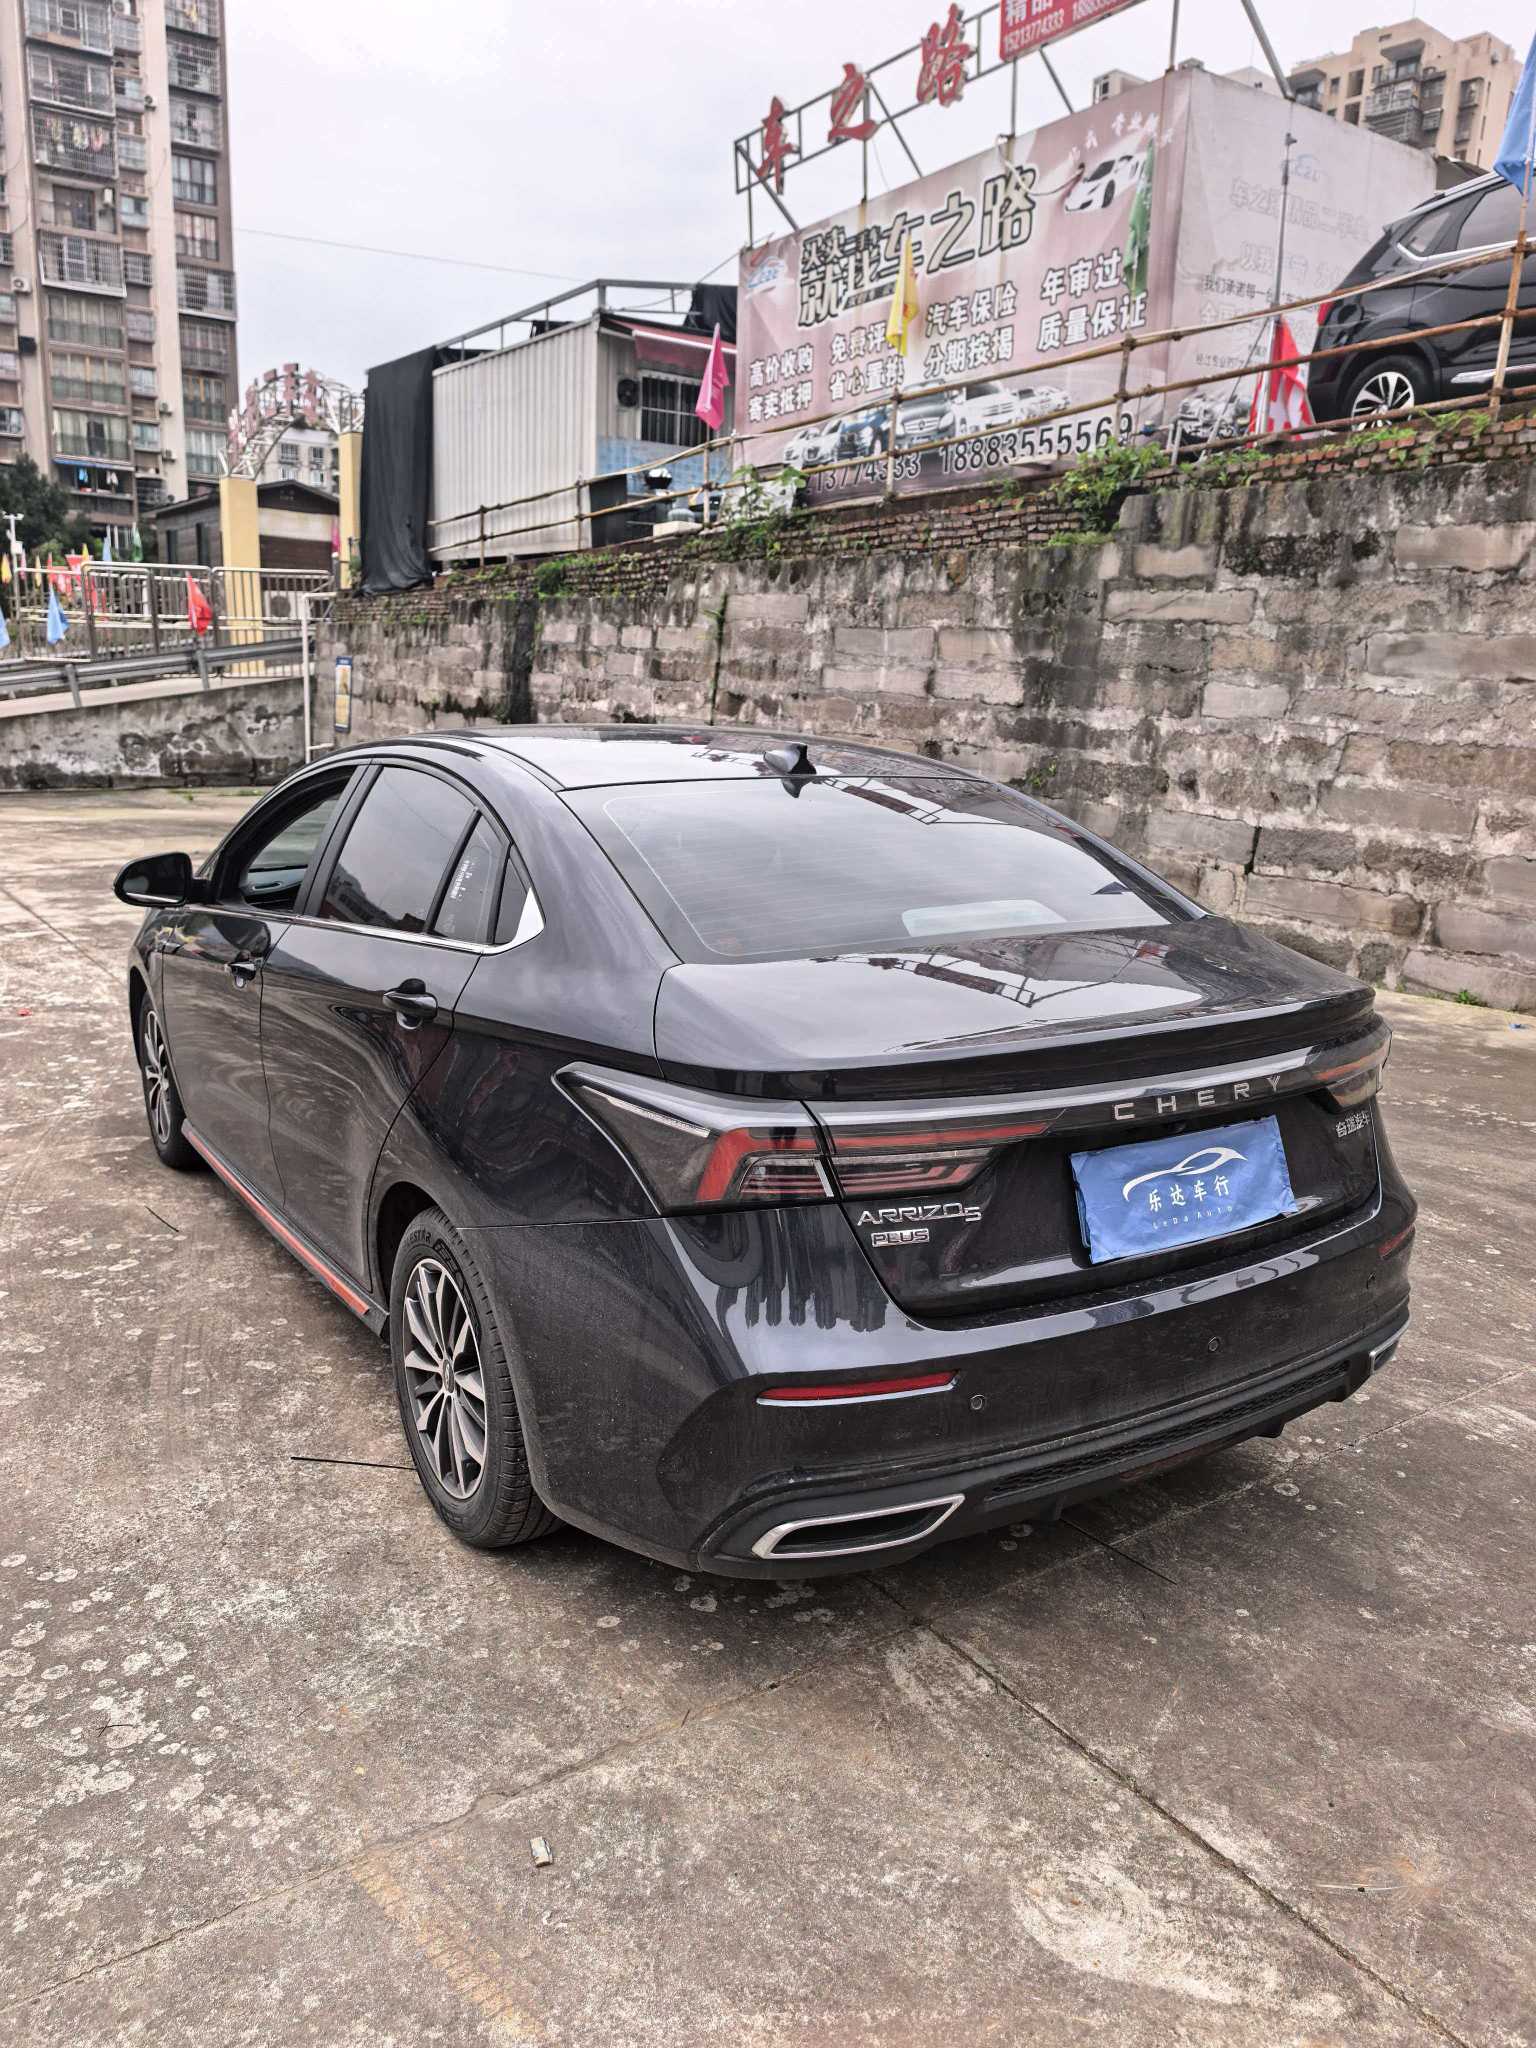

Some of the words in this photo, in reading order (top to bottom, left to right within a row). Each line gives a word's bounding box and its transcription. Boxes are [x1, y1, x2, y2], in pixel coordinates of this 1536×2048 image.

[1041, 248, 1129, 305] 年审过
[926, 281, 1018, 337] 汽车保险
[1037, 291, 1149, 352] 质量保证
[750, 342, 814, 390] 高价收购
[831, 320, 899, 366] 免费评
[924, 326, 1014, 380] 分期按揭
[748, 380, 813, 423] 寄卖抵押
[939, 412, 1135, 474] 18883555569
[1114, 1074, 1281, 1121] CHERY
[1149, 1174, 1230, 1213] 乐达车行
[871, 1228, 930, 1248] PLUS
